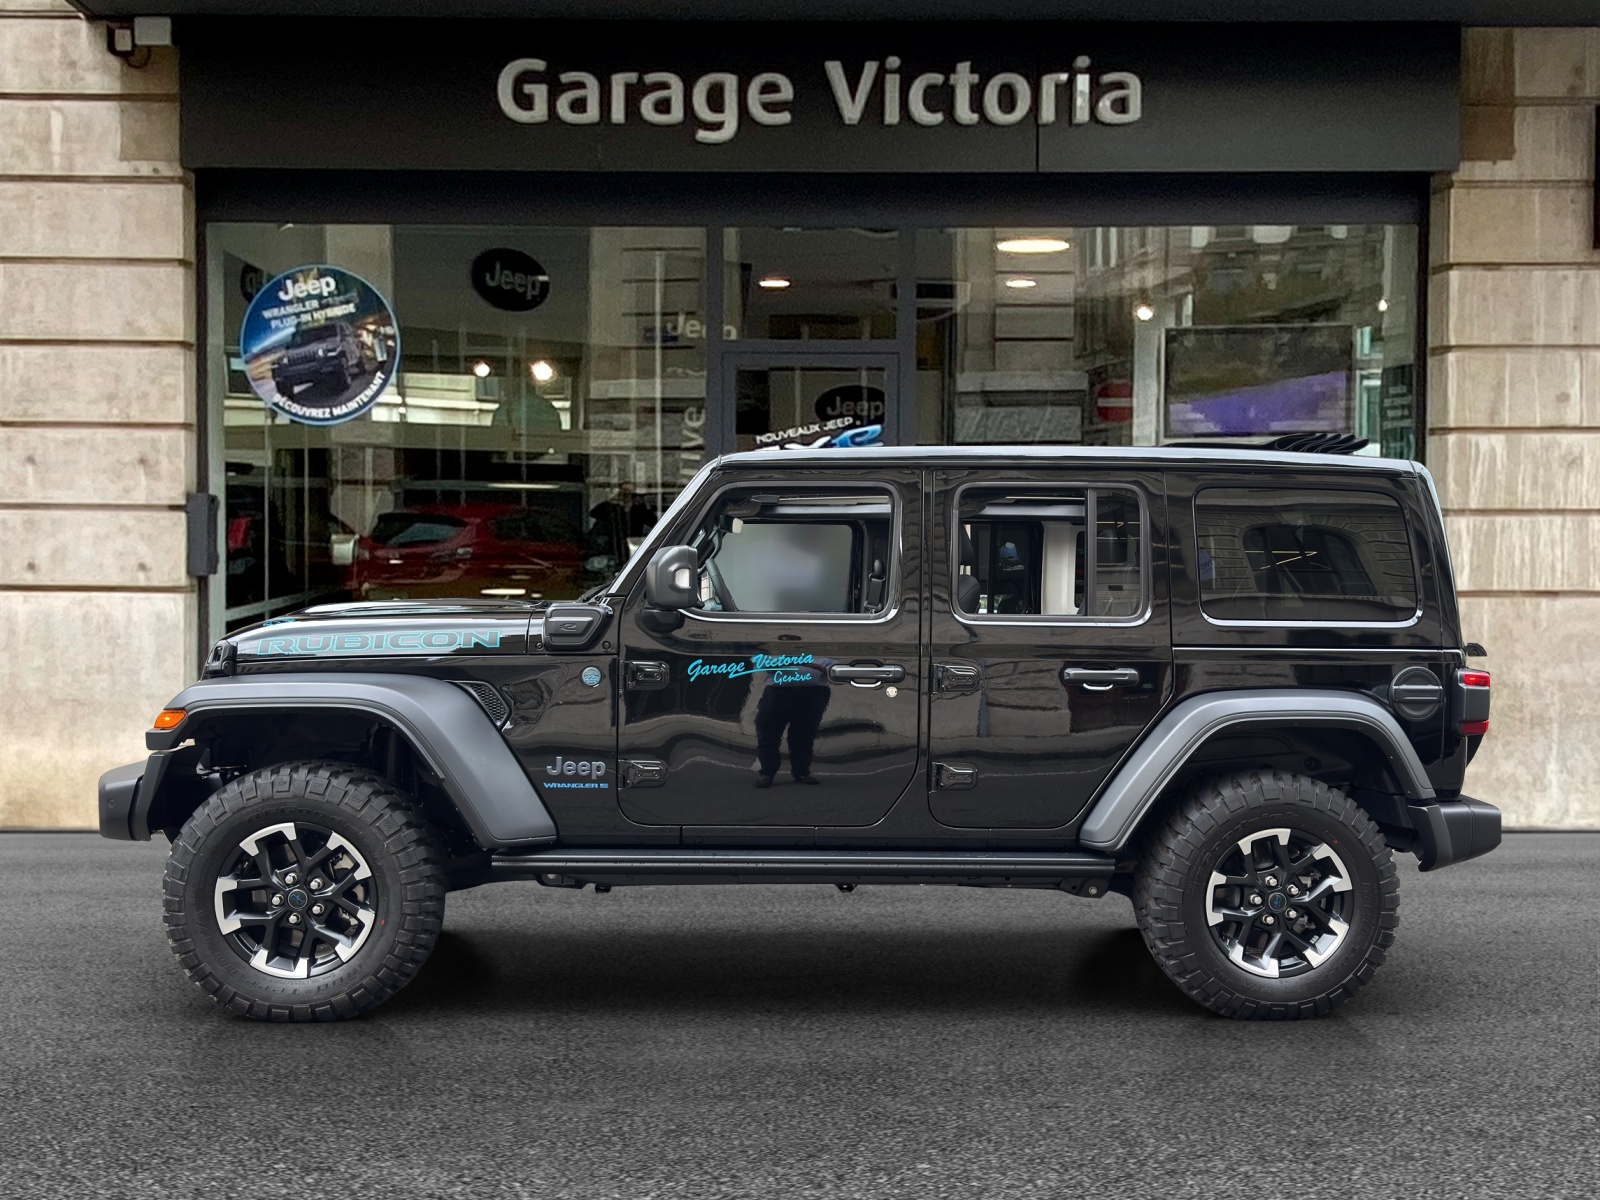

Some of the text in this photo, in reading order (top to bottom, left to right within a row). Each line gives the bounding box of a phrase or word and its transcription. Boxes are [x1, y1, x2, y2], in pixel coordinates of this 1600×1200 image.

[497, 55, 1142, 144] Garage Victoria
[278, 276, 336, 300] Jeep
[484, 260, 541, 300] Jeep
[262, 300, 320, 319] WRANGLER
[271, 313, 312, 329] PLUG-IN
[666, 311, 738, 340] Jep
[331, 370, 386, 417] MAINTENANT
[826, 396, 884, 420] Jeep
[756, 425, 820, 444] NOUVEAUX
[823, 416, 854, 431] JEEP
[256, 630, 501, 656] RUBICON
[687, 652, 814, 682] Garage Victoria
[773, 670, 813, 685] Genève
[546, 756, 606, 780] Jeep
